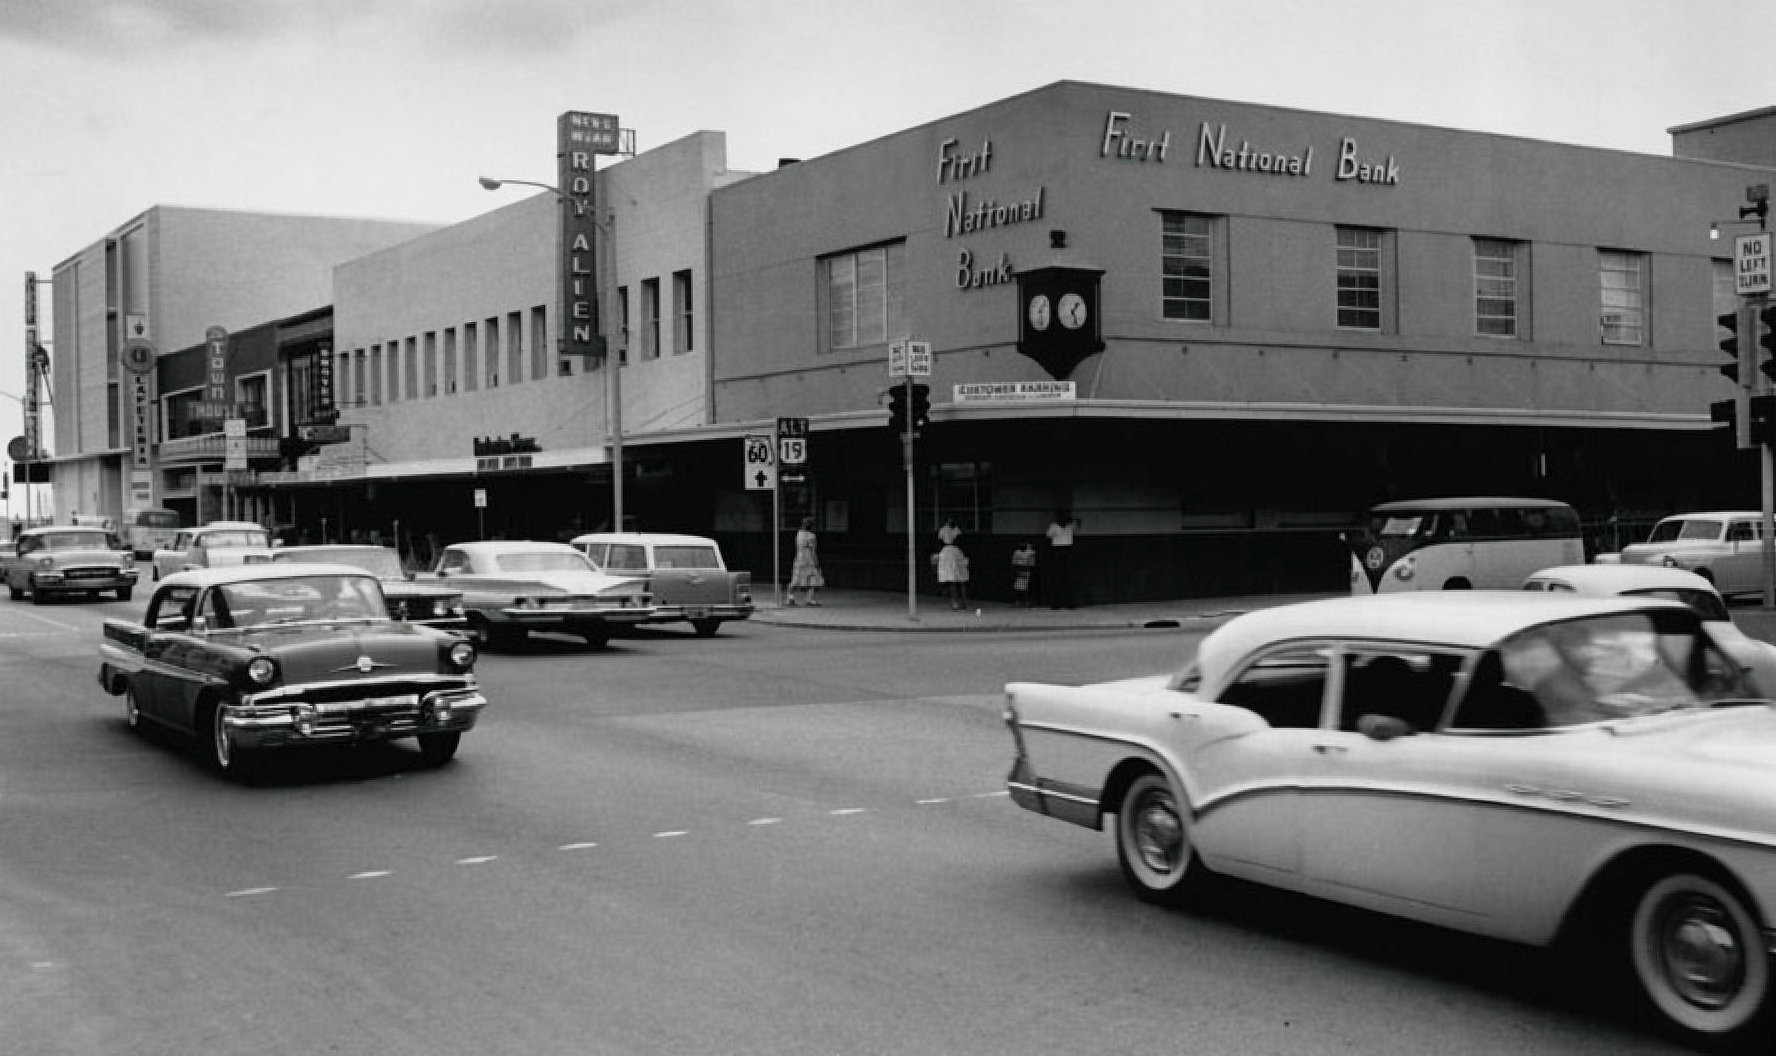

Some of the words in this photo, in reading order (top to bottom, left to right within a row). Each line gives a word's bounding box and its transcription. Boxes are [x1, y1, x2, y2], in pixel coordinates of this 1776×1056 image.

[1100, 111, 1169, 163] First
[1195, 121, 1313, 176] National
[1336, 136, 1399, 185] Bank
[937, 136, 993, 185] First
[944, 185, 1046, 238] National
[1743, 240, 1762, 256] NO
[956, 249, 1013, 290] Bank
[958, 384, 1016, 394] CUSTOMER
[780, 419, 807, 435] ALT
[748, 444, 767, 463] 60
[783, 441, 802, 459] 19
